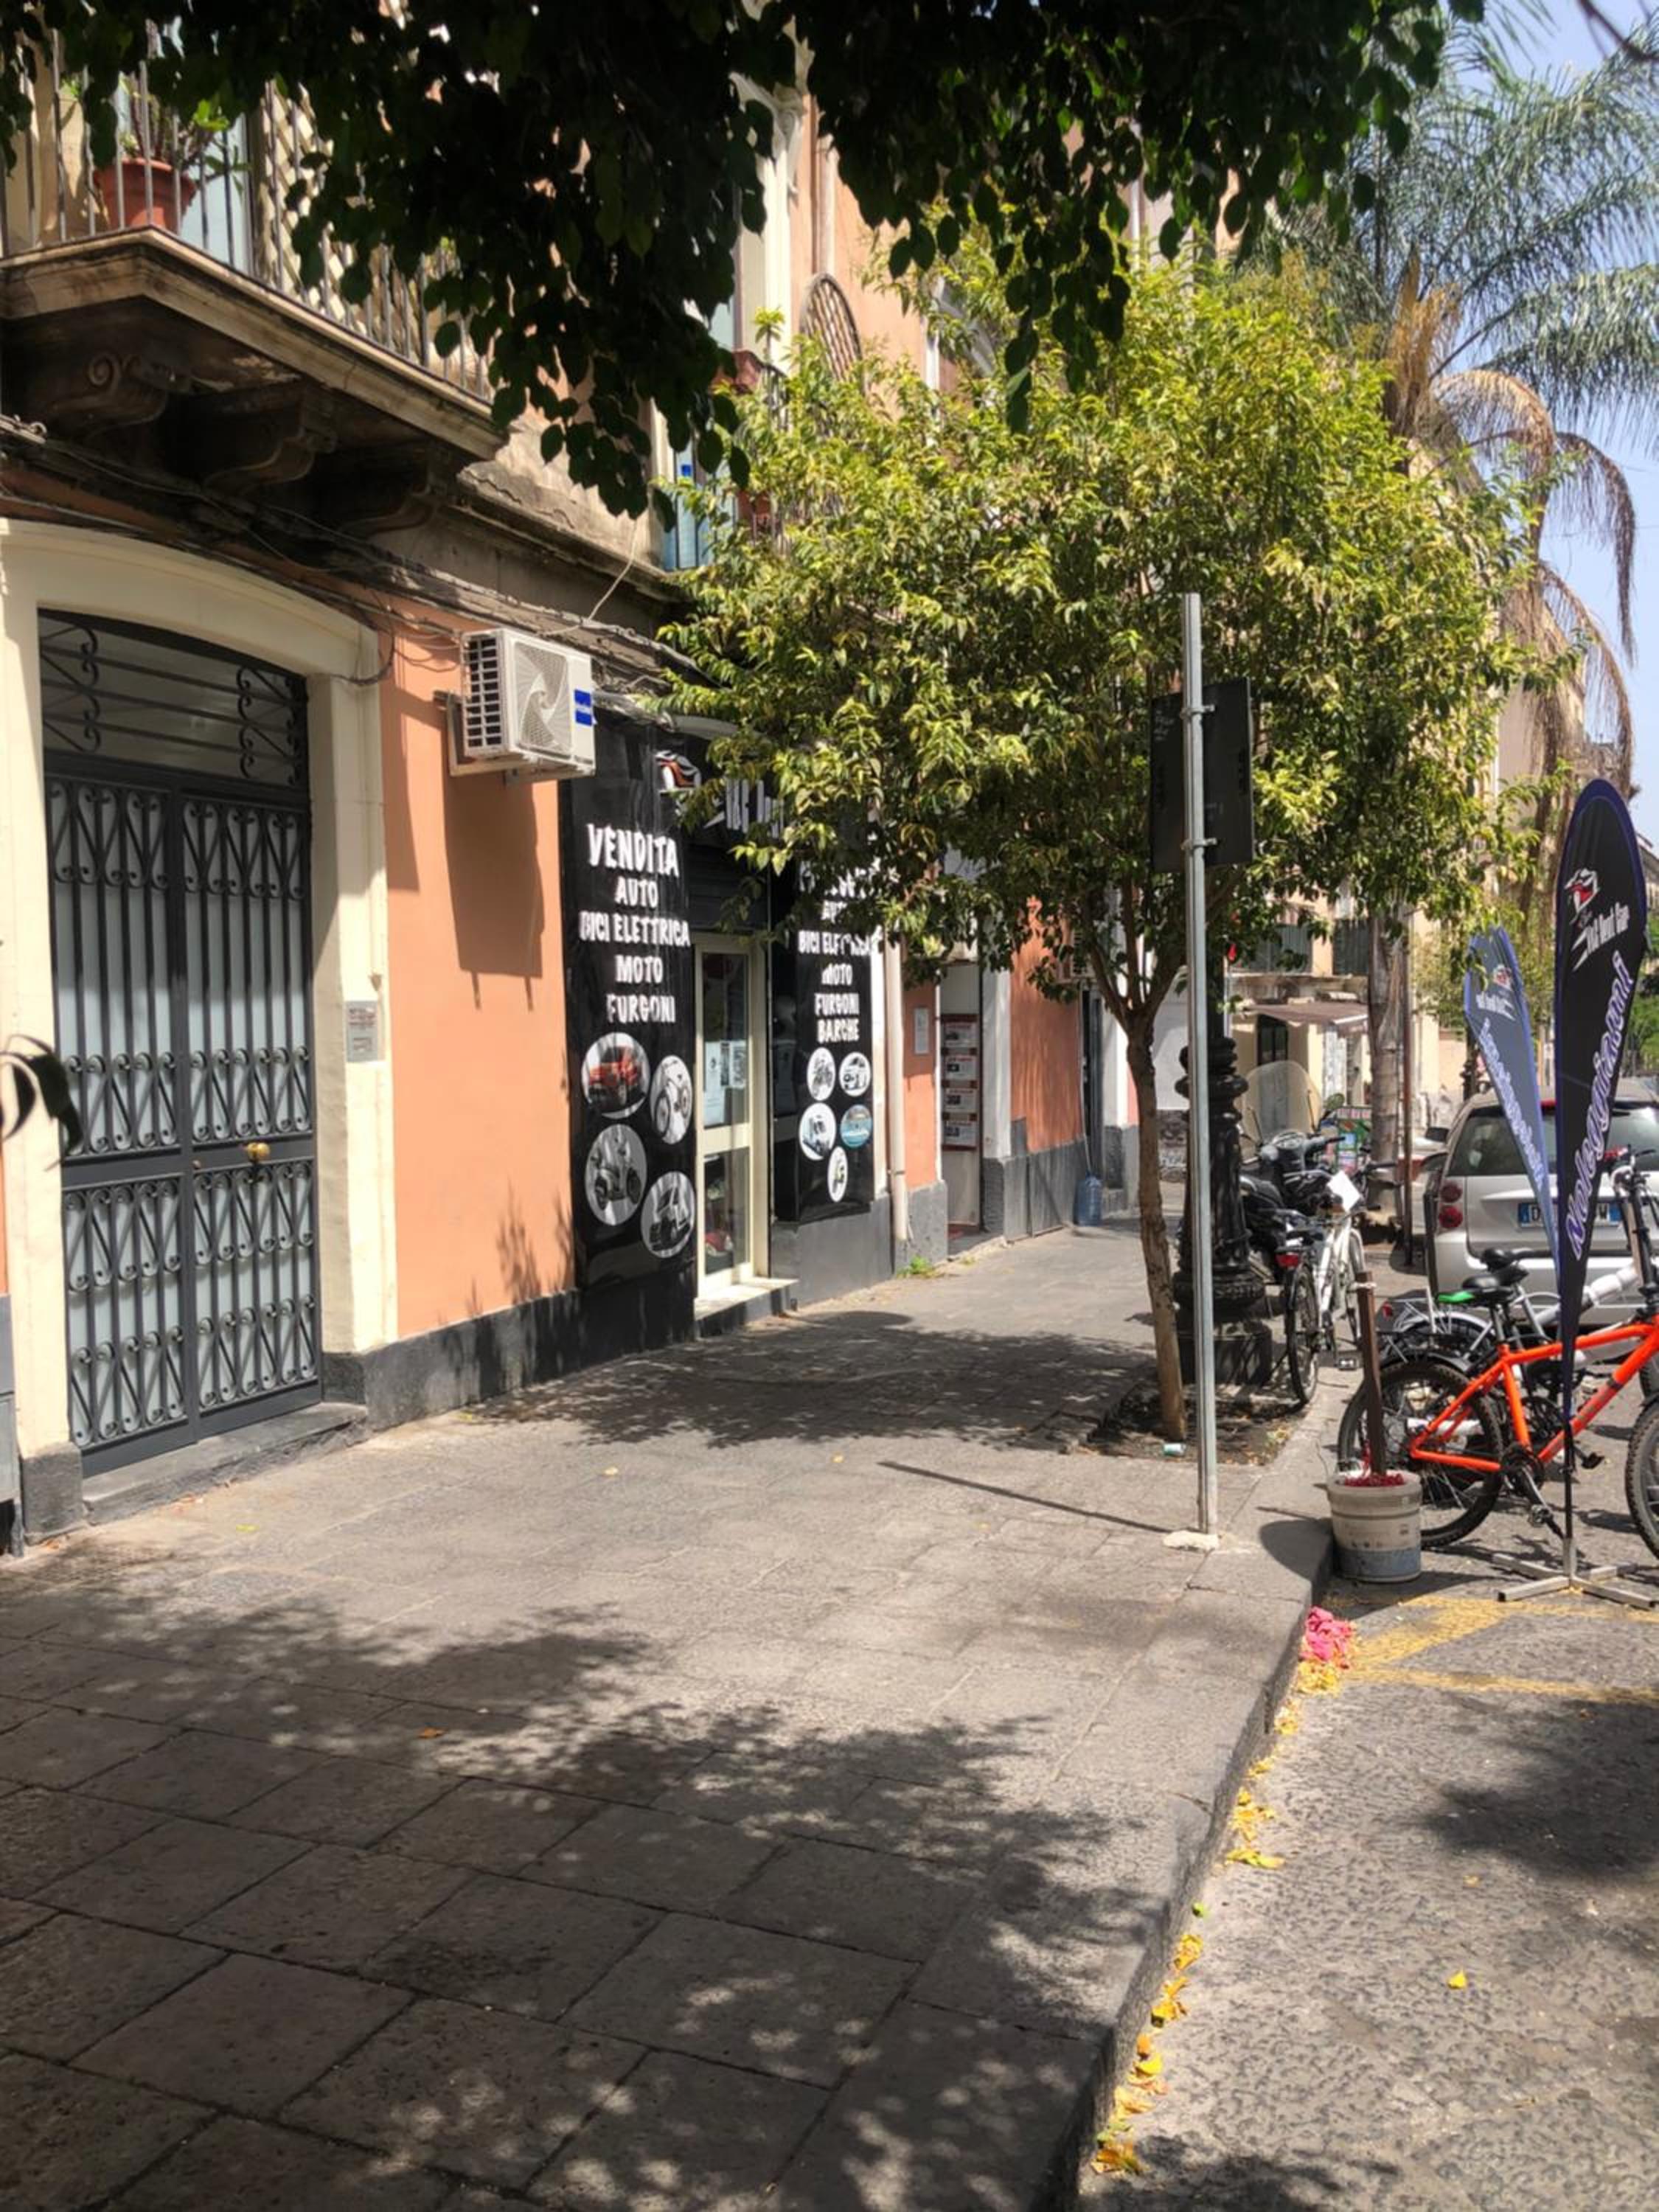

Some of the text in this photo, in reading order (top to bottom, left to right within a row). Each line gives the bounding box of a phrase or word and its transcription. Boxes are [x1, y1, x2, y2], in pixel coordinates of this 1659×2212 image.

[587, 823, 680, 877] VENDITA
[615, 876, 658, 908] AUTO
[579, 911, 691, 947] BICI ELETTRICA
[615, 955, 664, 984] MOTO
[821, 963, 853, 985] MOTO
[606, 994, 676, 1023] FURGONI
[814, 992, 860, 1016] FURGONI
[817, 1018, 859, 1043] BARCHE
